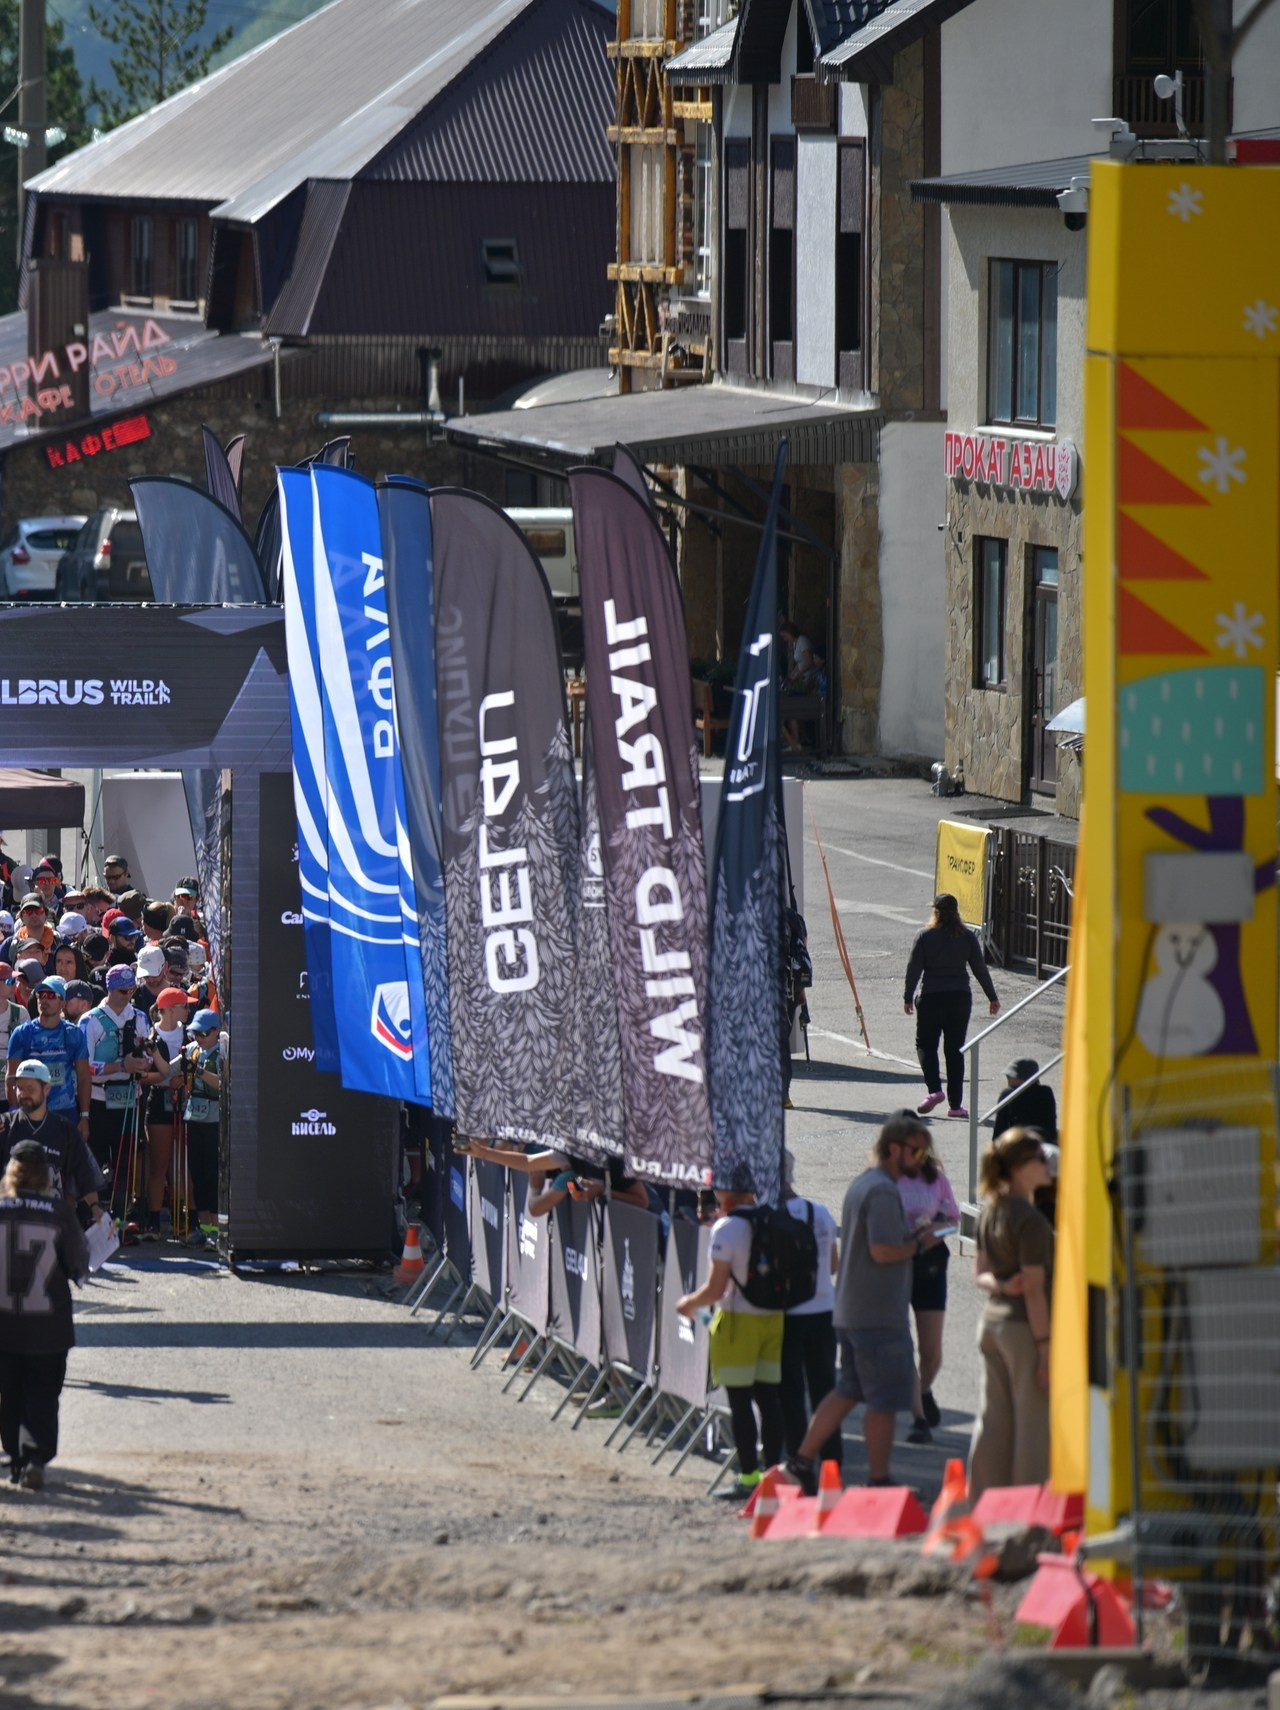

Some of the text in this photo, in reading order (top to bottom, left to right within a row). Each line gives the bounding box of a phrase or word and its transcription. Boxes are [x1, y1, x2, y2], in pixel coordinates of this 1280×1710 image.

[64, 318, 172, 373] РАЙД
[94, 354, 179, 396] ОТЕЛЬ
[46, 430, 115, 469] КАФЕ
[943, 431, 1057, 492] ПРОКАТ АЗАУ
[110, 679, 155, 693] WILD
[110, 692, 158, 706] TRAIL
[291, 1121, 337, 1136] КИСЕЛЬ
[24, 1199, 55, 1213] TRAIL
